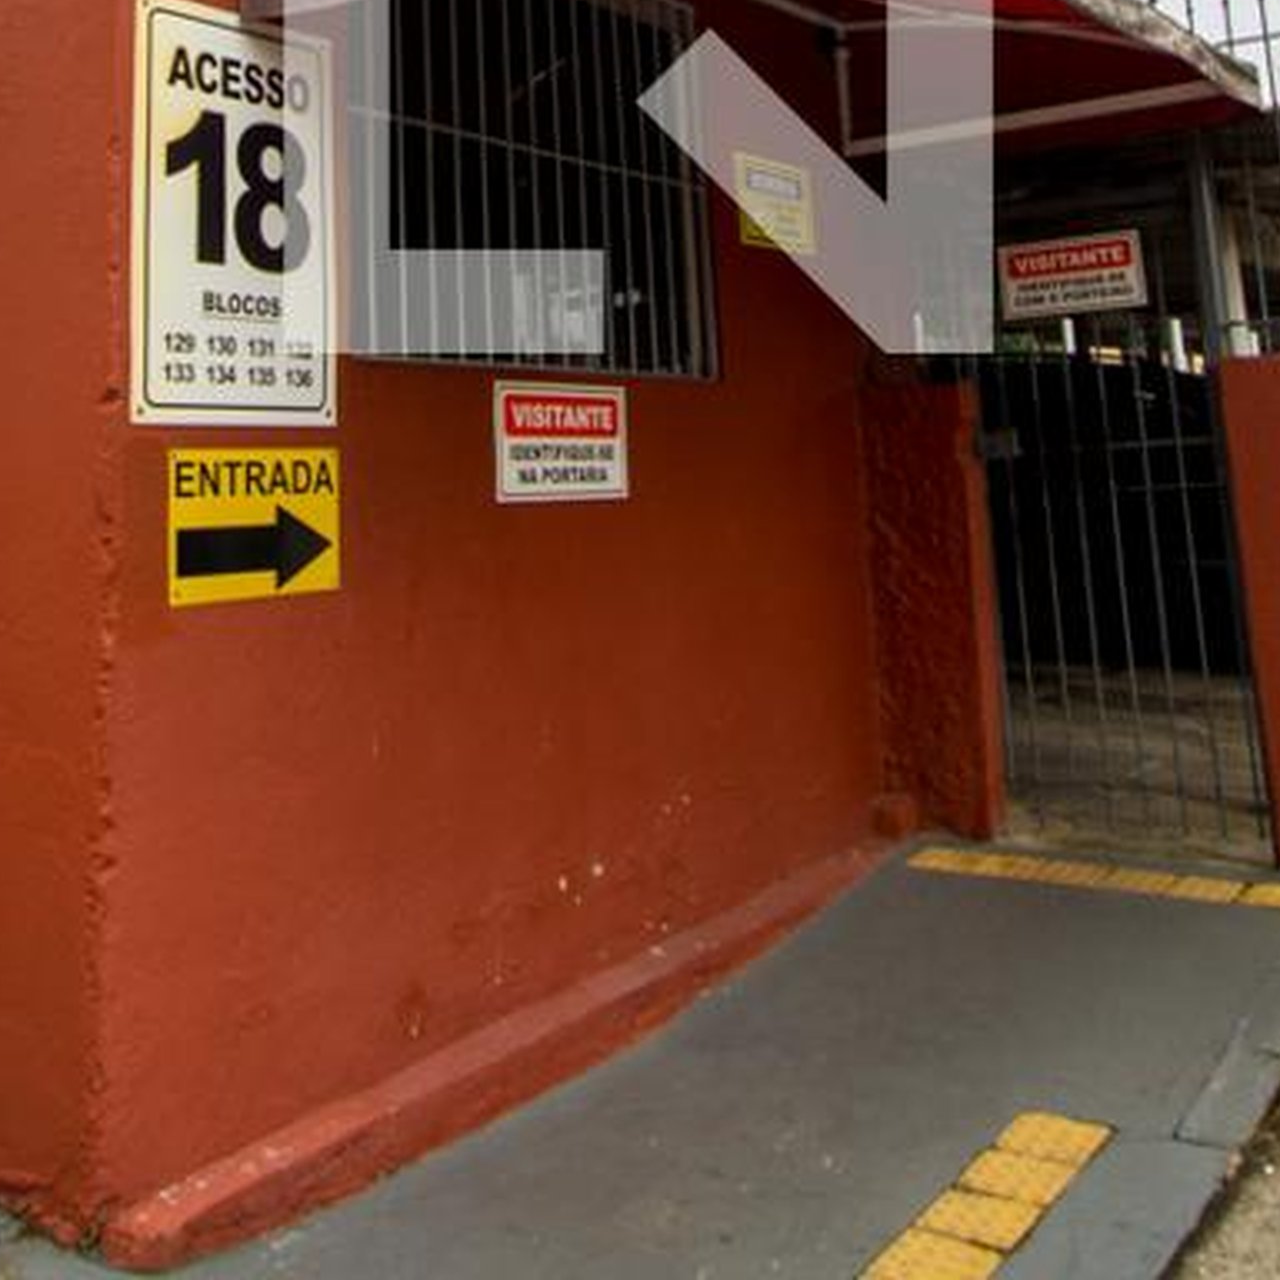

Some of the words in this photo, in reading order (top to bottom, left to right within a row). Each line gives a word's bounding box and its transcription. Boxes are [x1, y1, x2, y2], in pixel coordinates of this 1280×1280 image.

[167, 45, 309, 113] ACESSO
[166, 110, 311, 276] 18
[1014, 244, 1126, 273] VISITANTE
[202, 290, 283, 317] BLOCOS
[164, 332, 196, 354] 129
[207, 335, 238, 357] 130
[248, 338, 275, 358] 131
[164, 363, 196, 383] 133
[207, 365, 237, 385] 134
[248, 367, 277, 387] 135
[286, 368, 315, 388] 136
[509, 399, 614, 431] VISITANTE
[174, 458, 335, 498] ENTRADA
[518, 467, 538, 484] NA
[541, 466, 608, 484] PORTARIA
